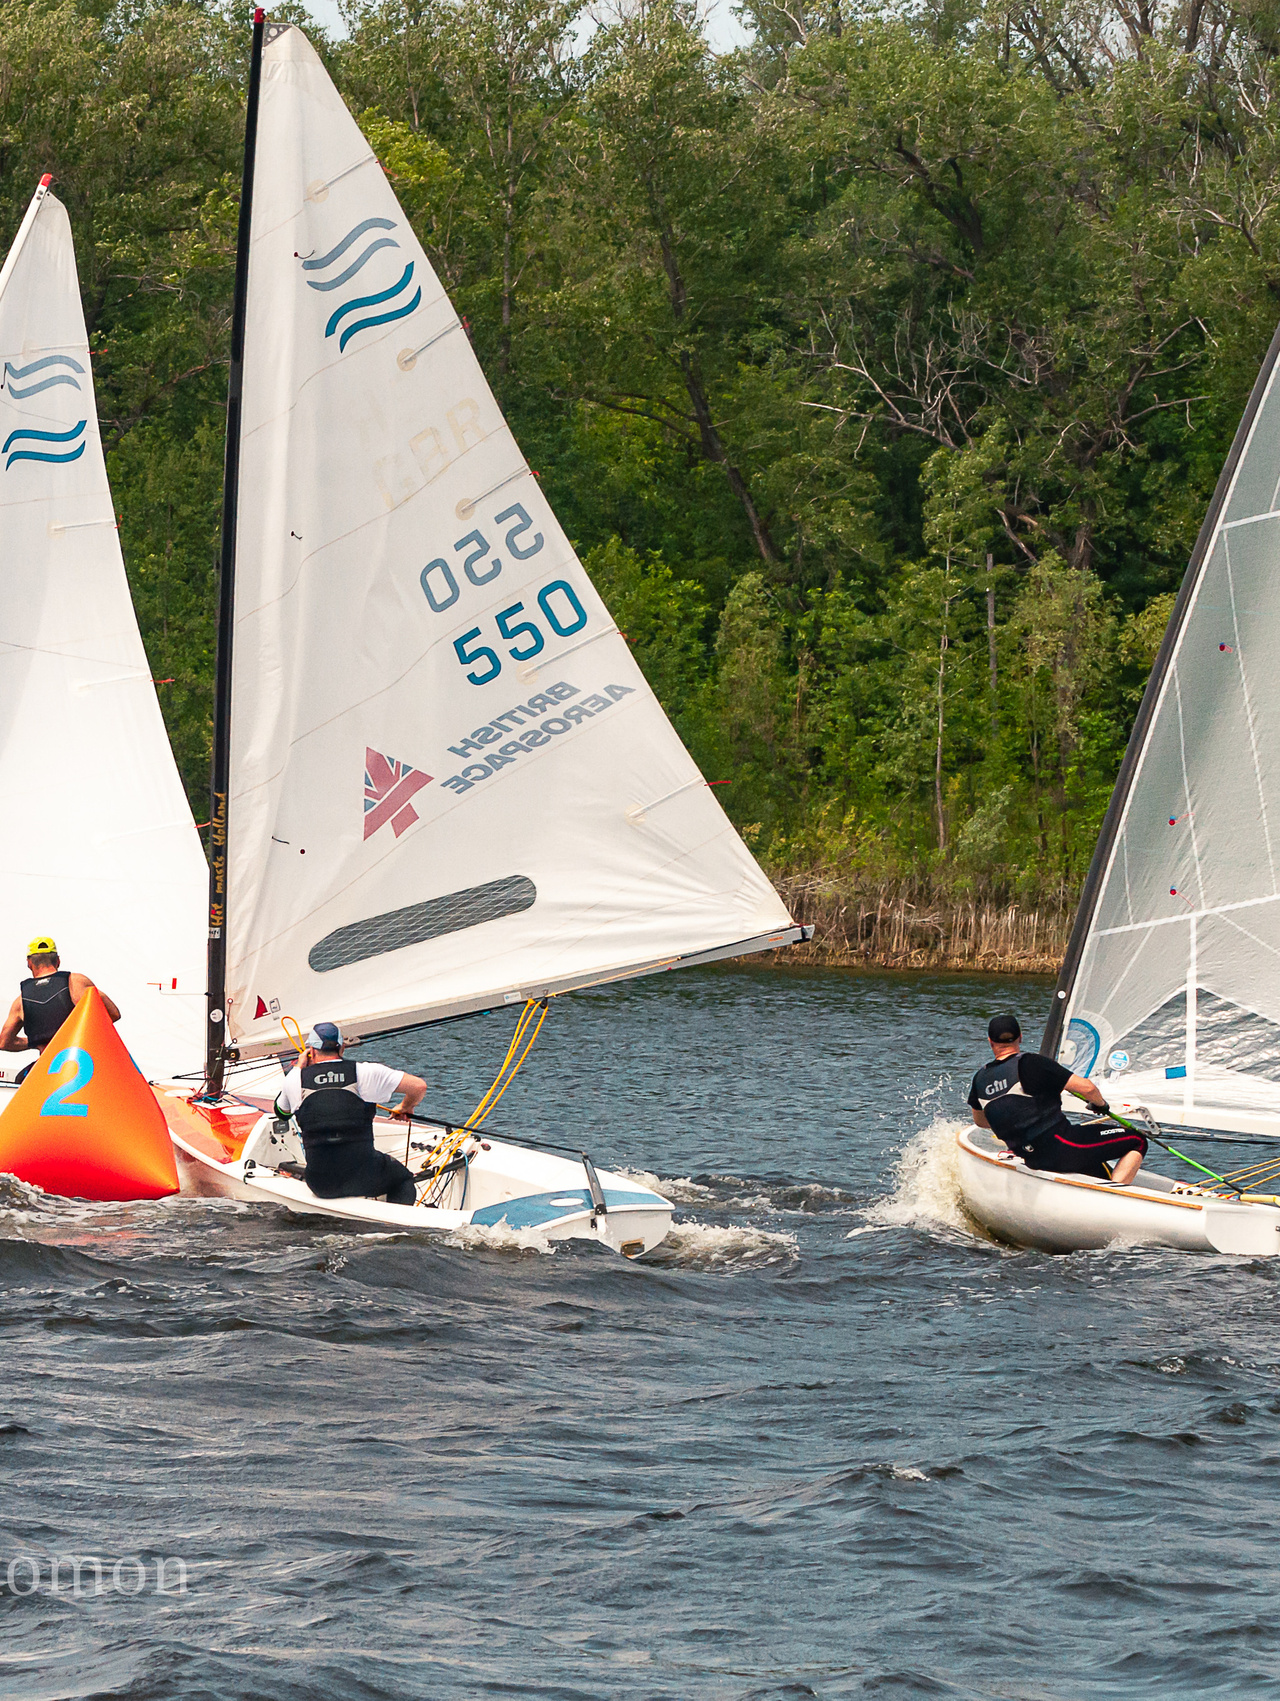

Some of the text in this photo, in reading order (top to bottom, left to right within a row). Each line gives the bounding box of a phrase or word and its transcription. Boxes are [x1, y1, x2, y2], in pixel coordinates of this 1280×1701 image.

[453, 580, 588, 686] 550
[212, 792, 227, 846] Holland
[40, 1046, 94, 1117] 2
[314, 1071, 345, 1084] Gill
[985, 1079, 1008, 1095] Gill
